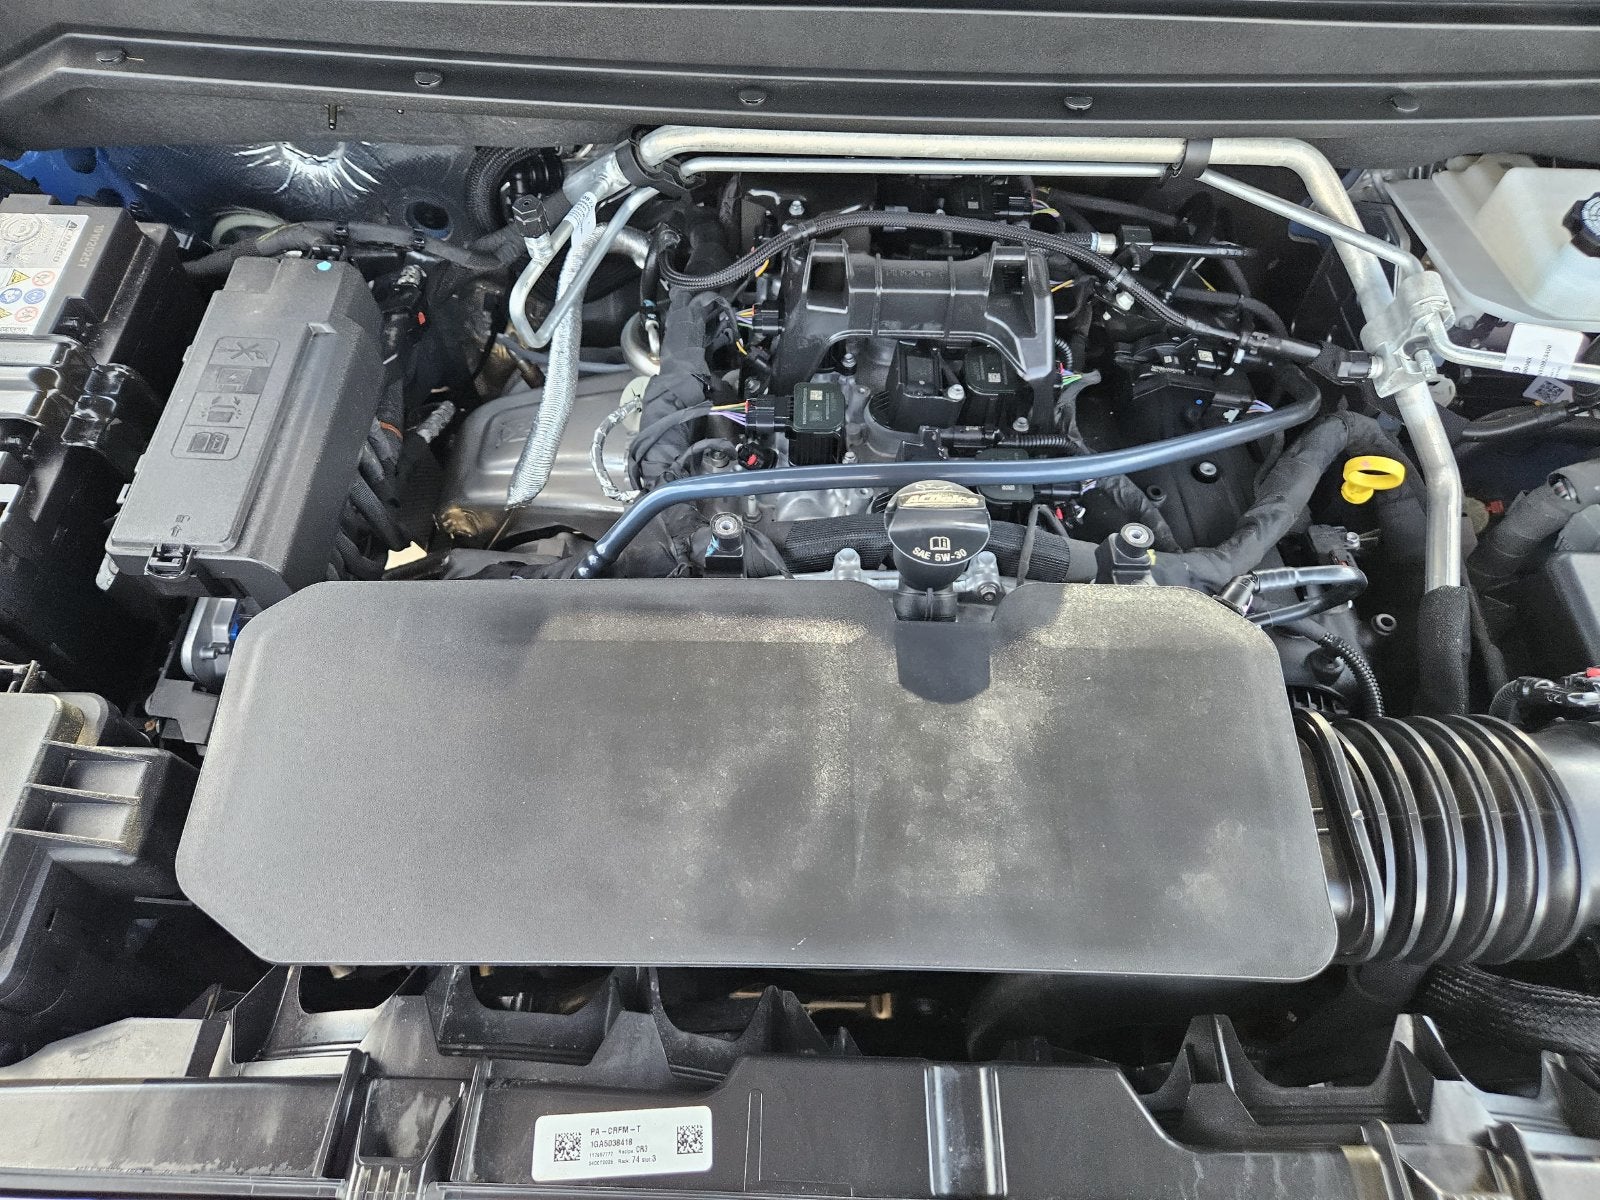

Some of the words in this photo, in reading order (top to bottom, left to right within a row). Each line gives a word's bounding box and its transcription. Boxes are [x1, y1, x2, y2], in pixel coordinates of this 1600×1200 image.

[912, 546, 931, 560] SAE
[934, 548, 967, 562] 5W-30
[631, 1155, 640, 1163] 74
